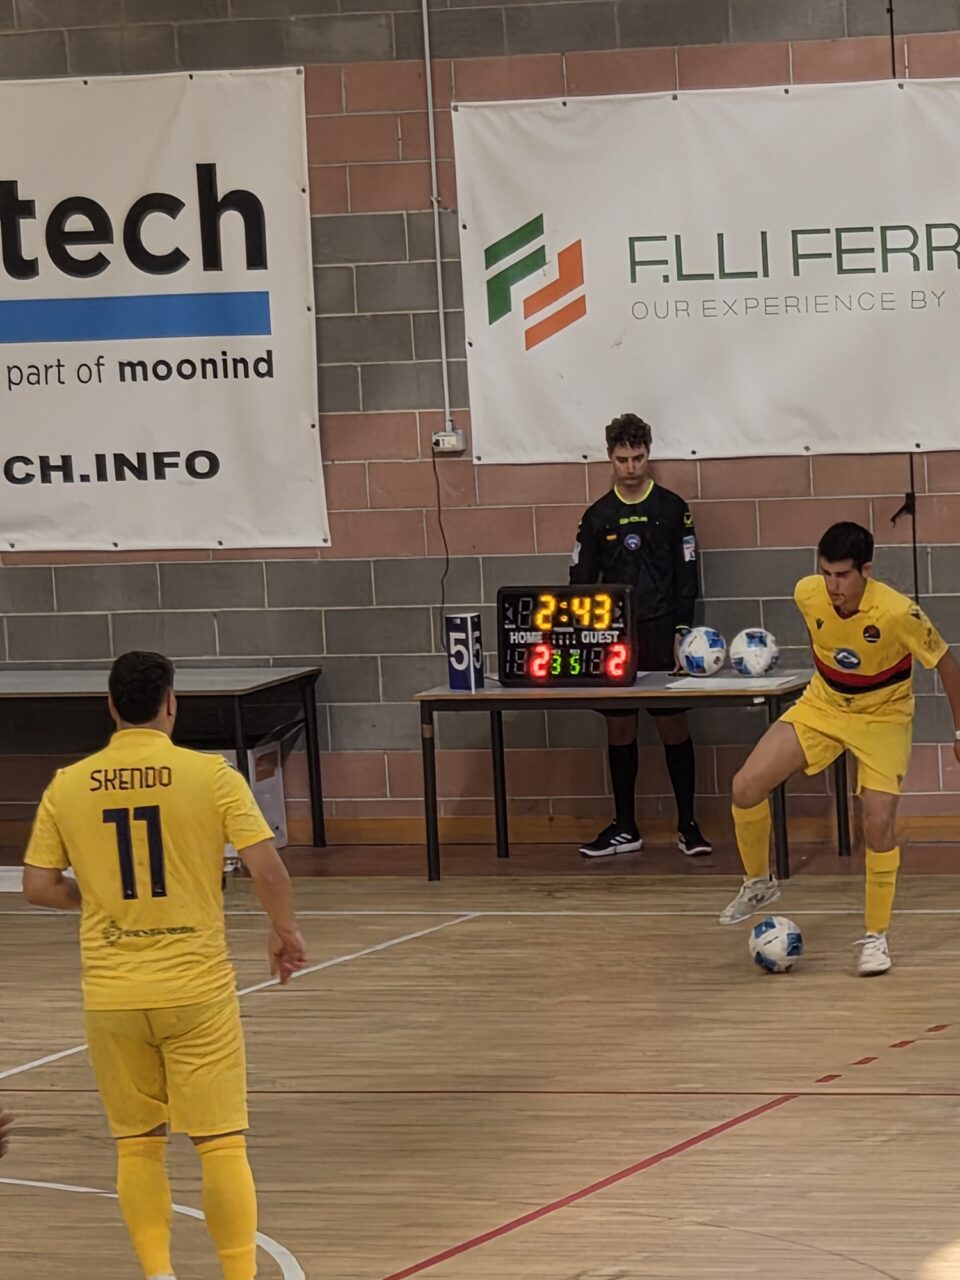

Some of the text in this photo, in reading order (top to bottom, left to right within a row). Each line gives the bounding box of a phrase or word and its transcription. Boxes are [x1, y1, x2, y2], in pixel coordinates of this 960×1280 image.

[0, 162, 268, 281] tech
[628, 230, 770, 284] F.LLI
[631, 300, 691, 321] OUR
[702, 291, 897, 319] EXPERIENCE
[910, 289, 947, 310] BY
[6, 349, 274, 392] part of moonind
[3, 450, 220, 485] CH.INFO
[534, 593, 612, 630] 2:43
[449, 631, 470, 671] 5
[509, 631, 620, 644] HOME GUEST
[530, 643, 627, 677] 2 3 5 2
[89, 766, 172, 792] SKENDO
[102, 804, 168, 900] 11
